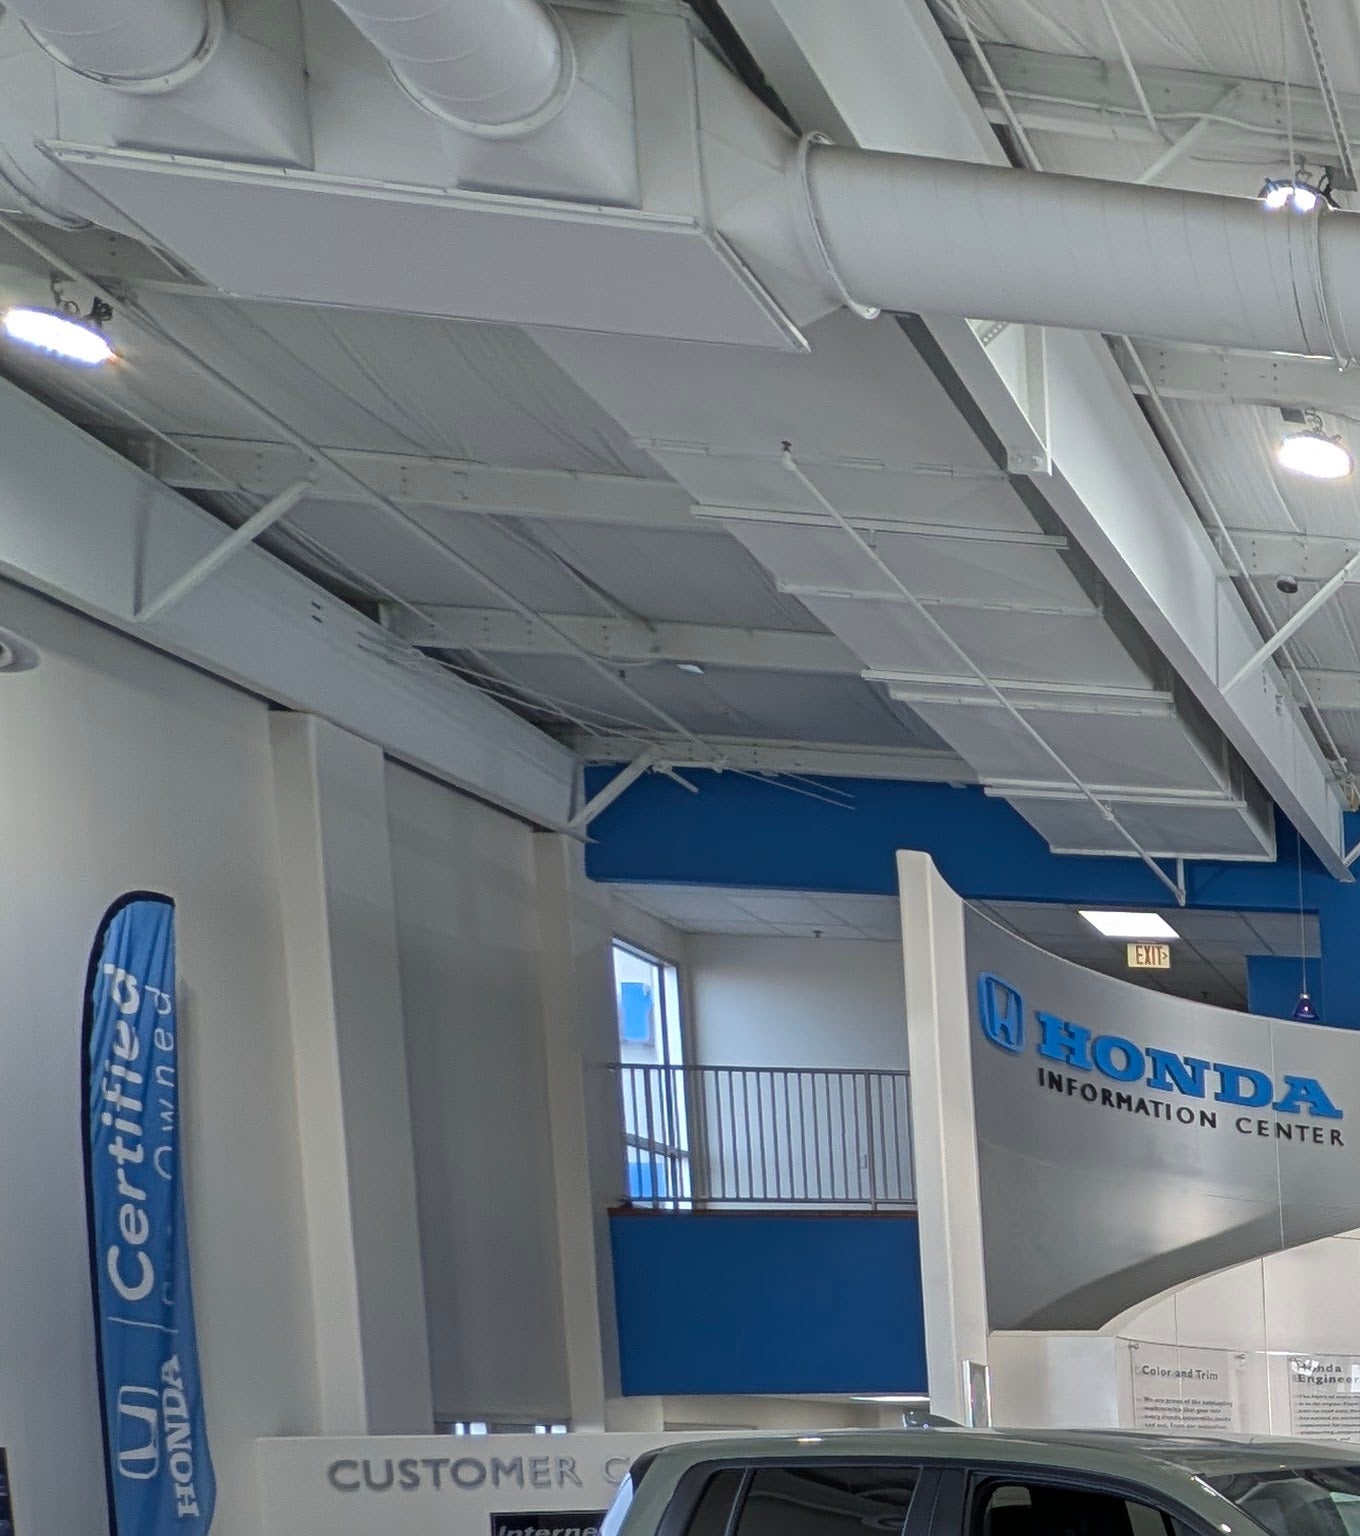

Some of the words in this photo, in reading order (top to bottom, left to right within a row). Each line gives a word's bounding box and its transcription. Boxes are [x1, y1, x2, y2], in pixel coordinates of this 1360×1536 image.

[1135, 945, 1163, 966] EXIT
[1037, 1011, 1345, 1119] HONDA
[100, 962, 154, 1302] Certified
[1038, 1066, 1218, 1130] INFORMATION
[1236, 1117, 1346, 1147] CENTER
[1142, 1365, 1172, 1377] Color
[1175, 1368, 1193, 1379] and
[1195, 1370, 1218, 1381] Trim
[158, 1354, 200, 1518] HONDA
[327, 1455, 583, 1493] CUSTOMER
